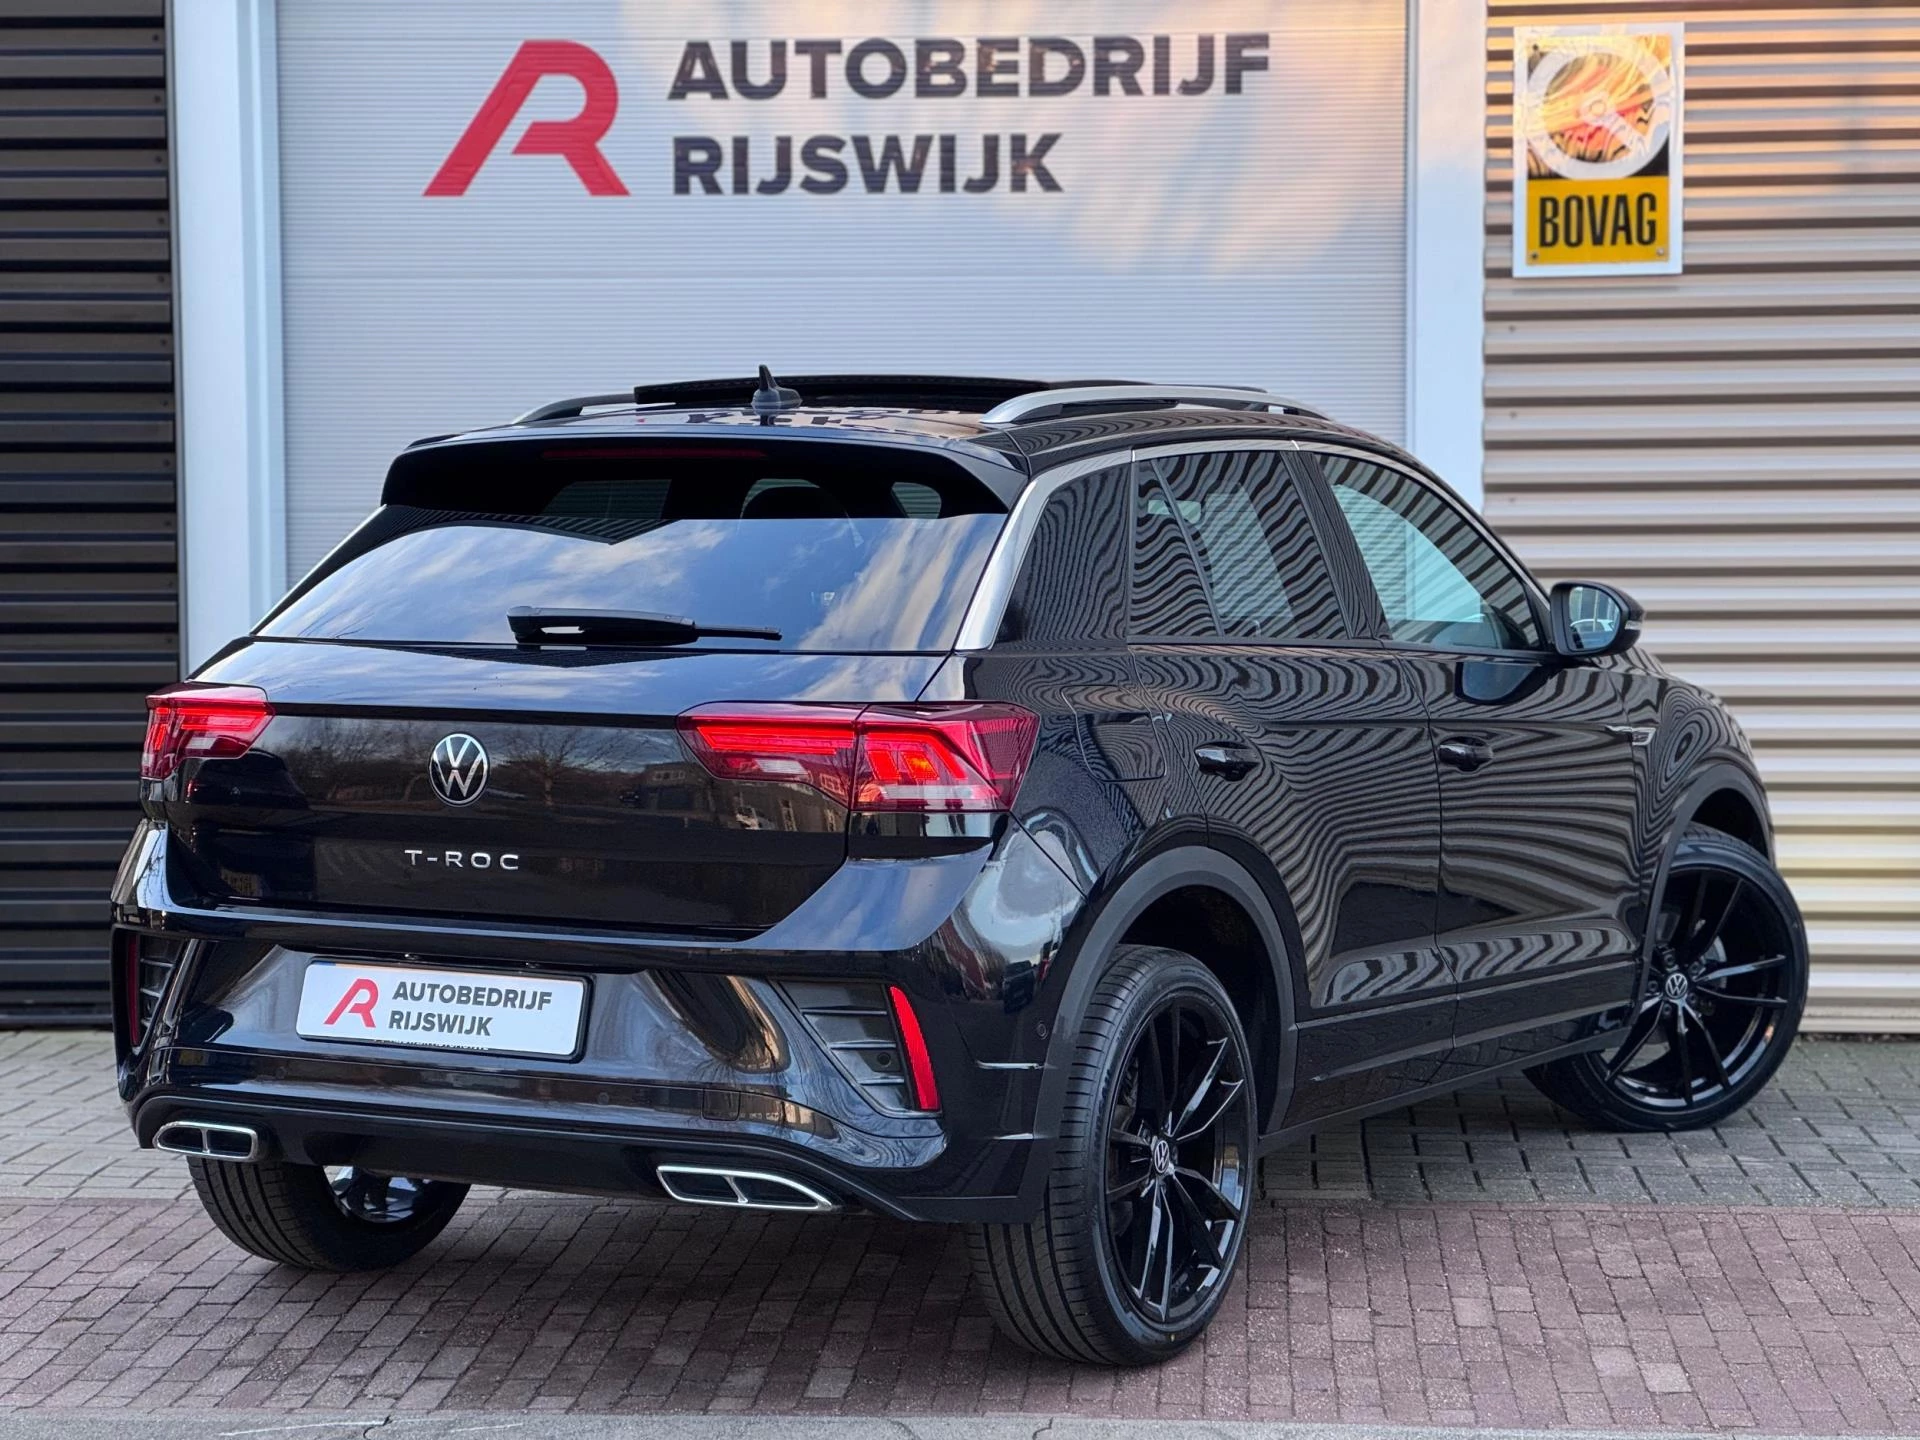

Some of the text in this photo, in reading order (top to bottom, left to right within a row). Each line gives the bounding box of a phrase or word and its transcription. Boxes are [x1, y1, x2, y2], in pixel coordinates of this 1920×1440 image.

[668, 33, 1270, 100] AUTOBEDRIJF
[672, 132, 1064, 195] RIJSWIJK
[1539, 192, 1657, 249] BOVAG
[430, 733, 487, 806] VW
[404, 849, 520, 871] T-ROC
[388, 1011, 492, 1036] RIJSWIJK
[391, 981, 552, 1011] AUTOBEDRIJF
